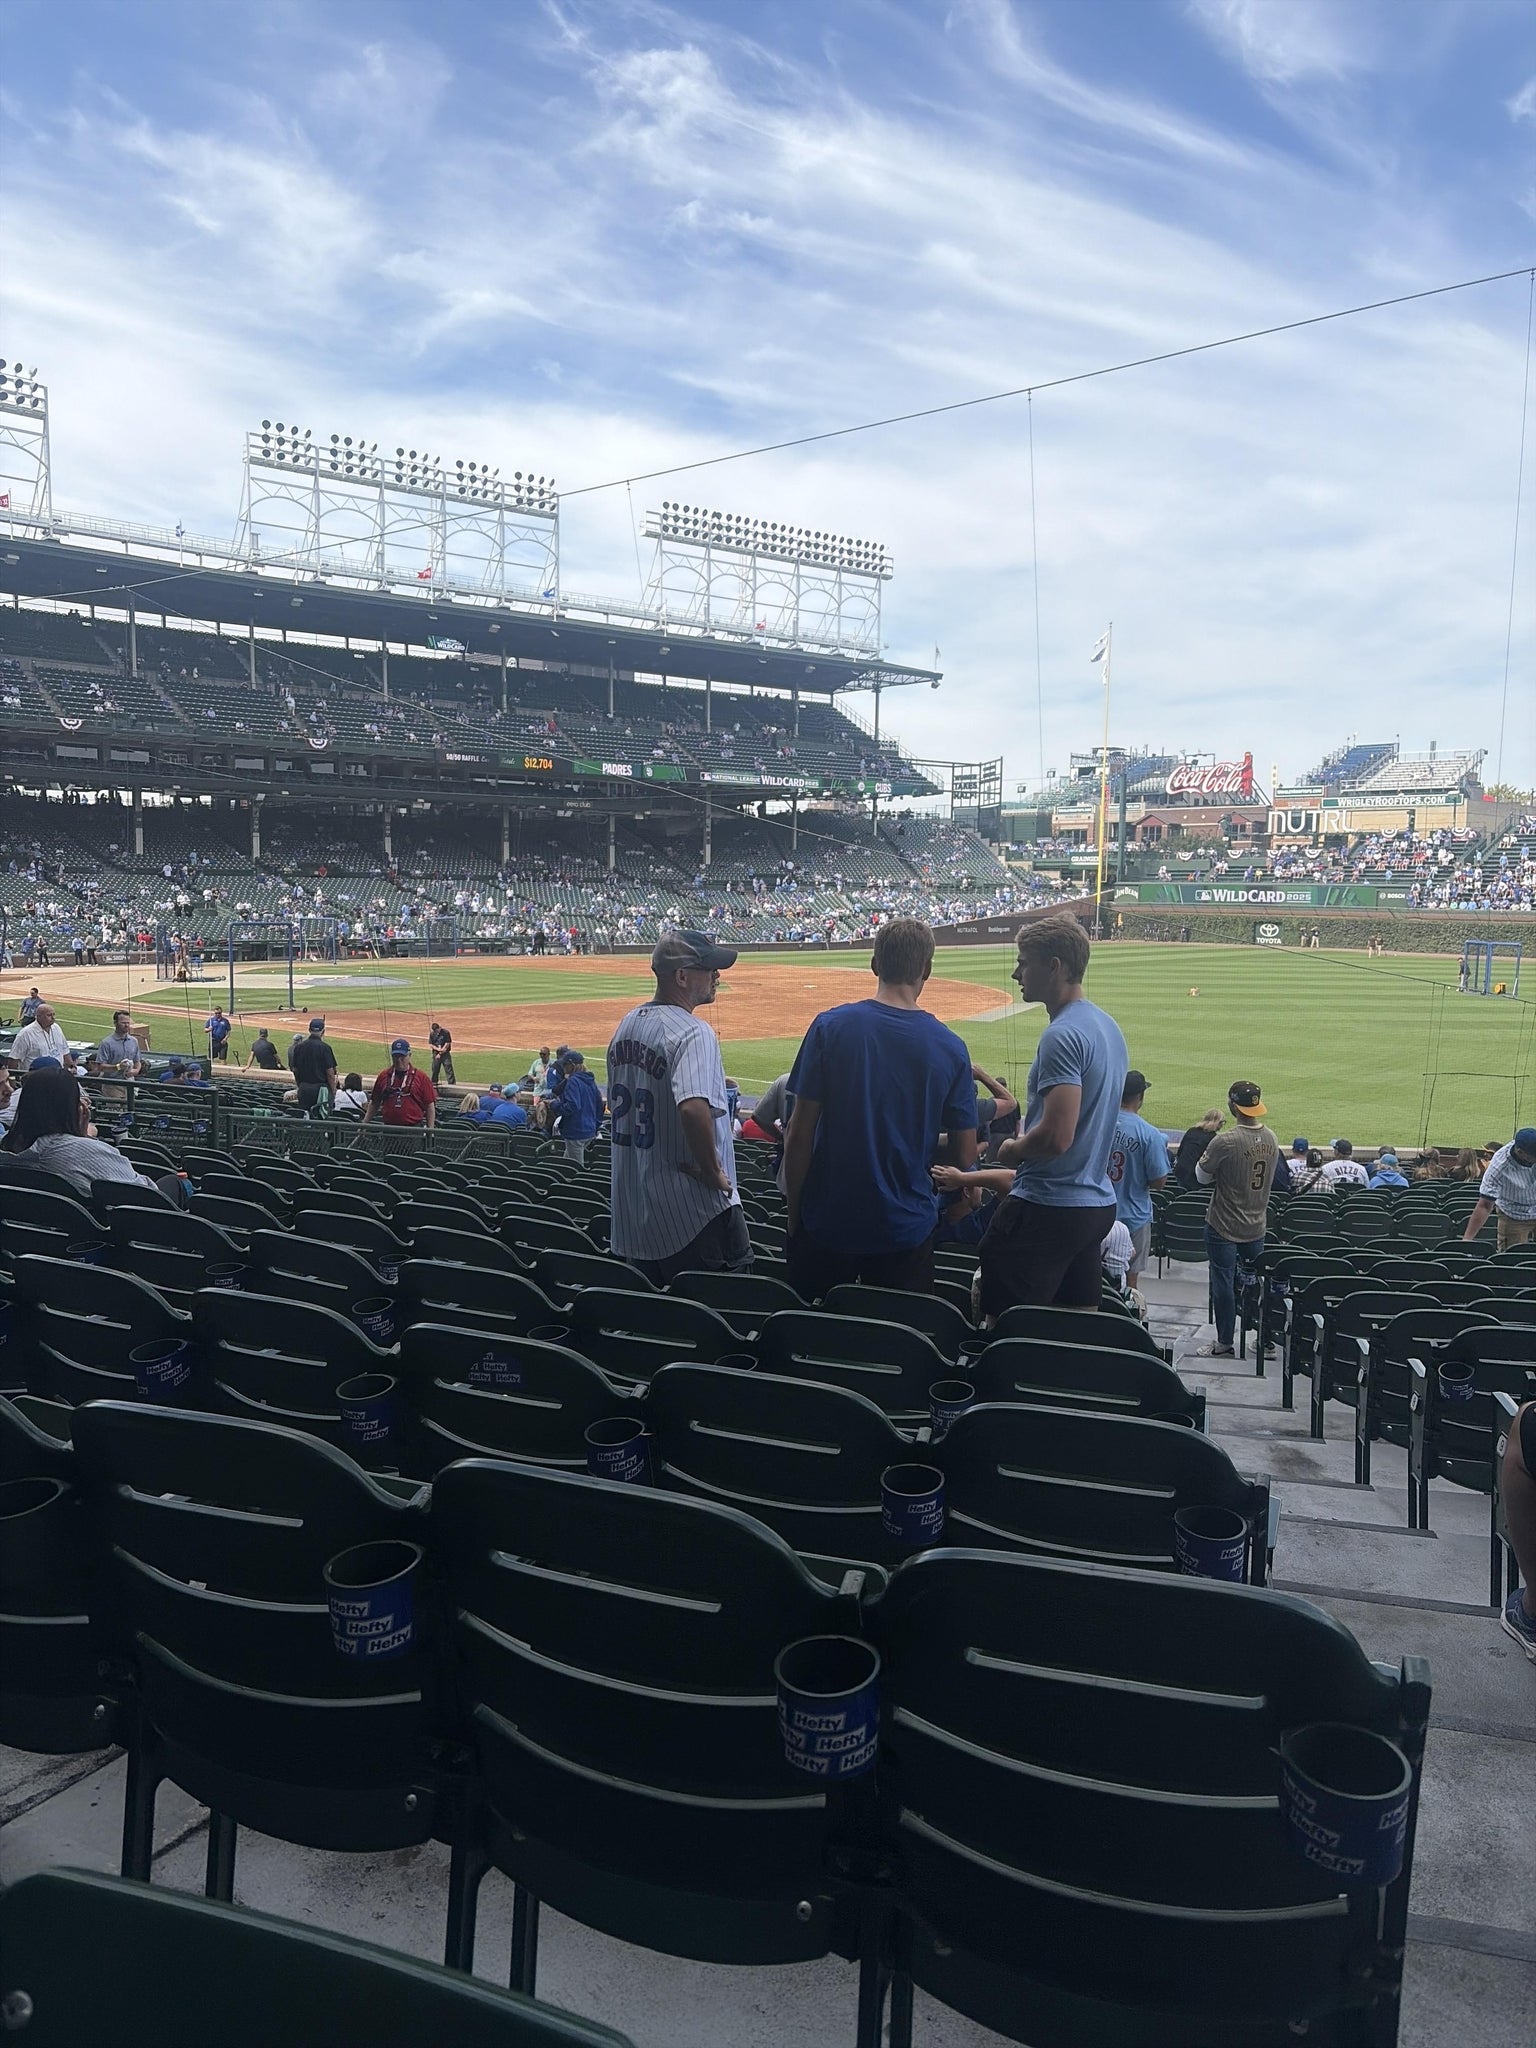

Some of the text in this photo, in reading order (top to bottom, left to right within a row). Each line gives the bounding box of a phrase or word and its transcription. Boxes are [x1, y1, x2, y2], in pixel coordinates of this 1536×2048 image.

[446, 753, 461, 761] 50/50
[461, 754, 479, 762] RAFFLE
[524, 757, 553, 769] $12,704
[602, 763, 632, 776] PADRES
[1166, 763, 1245, 794] Coca-Cola
[875, 783, 891, 793] CUBS
[1124, 886, 1138, 899] BEAM
[1286, 893, 1312, 901] 2025
[611, 1083, 656, 1150] 23
[1250, 1160, 1267, 1192] 3
[1335, 1166, 1359, 1176] RIZZO
[910, 1502, 936, 1513] Hefty
[331, 1600, 367, 1615] Hefty
[348, 1620, 390, 1633] Hefty
[370, 1630, 409, 1652] Hefty
[796, 1714, 841, 1731] Hefty
[820, 1731, 864, 1750] Hefty
[787, 1750, 825, 1771] Hefty
[1308, 1845, 1360, 1874] Hefty
